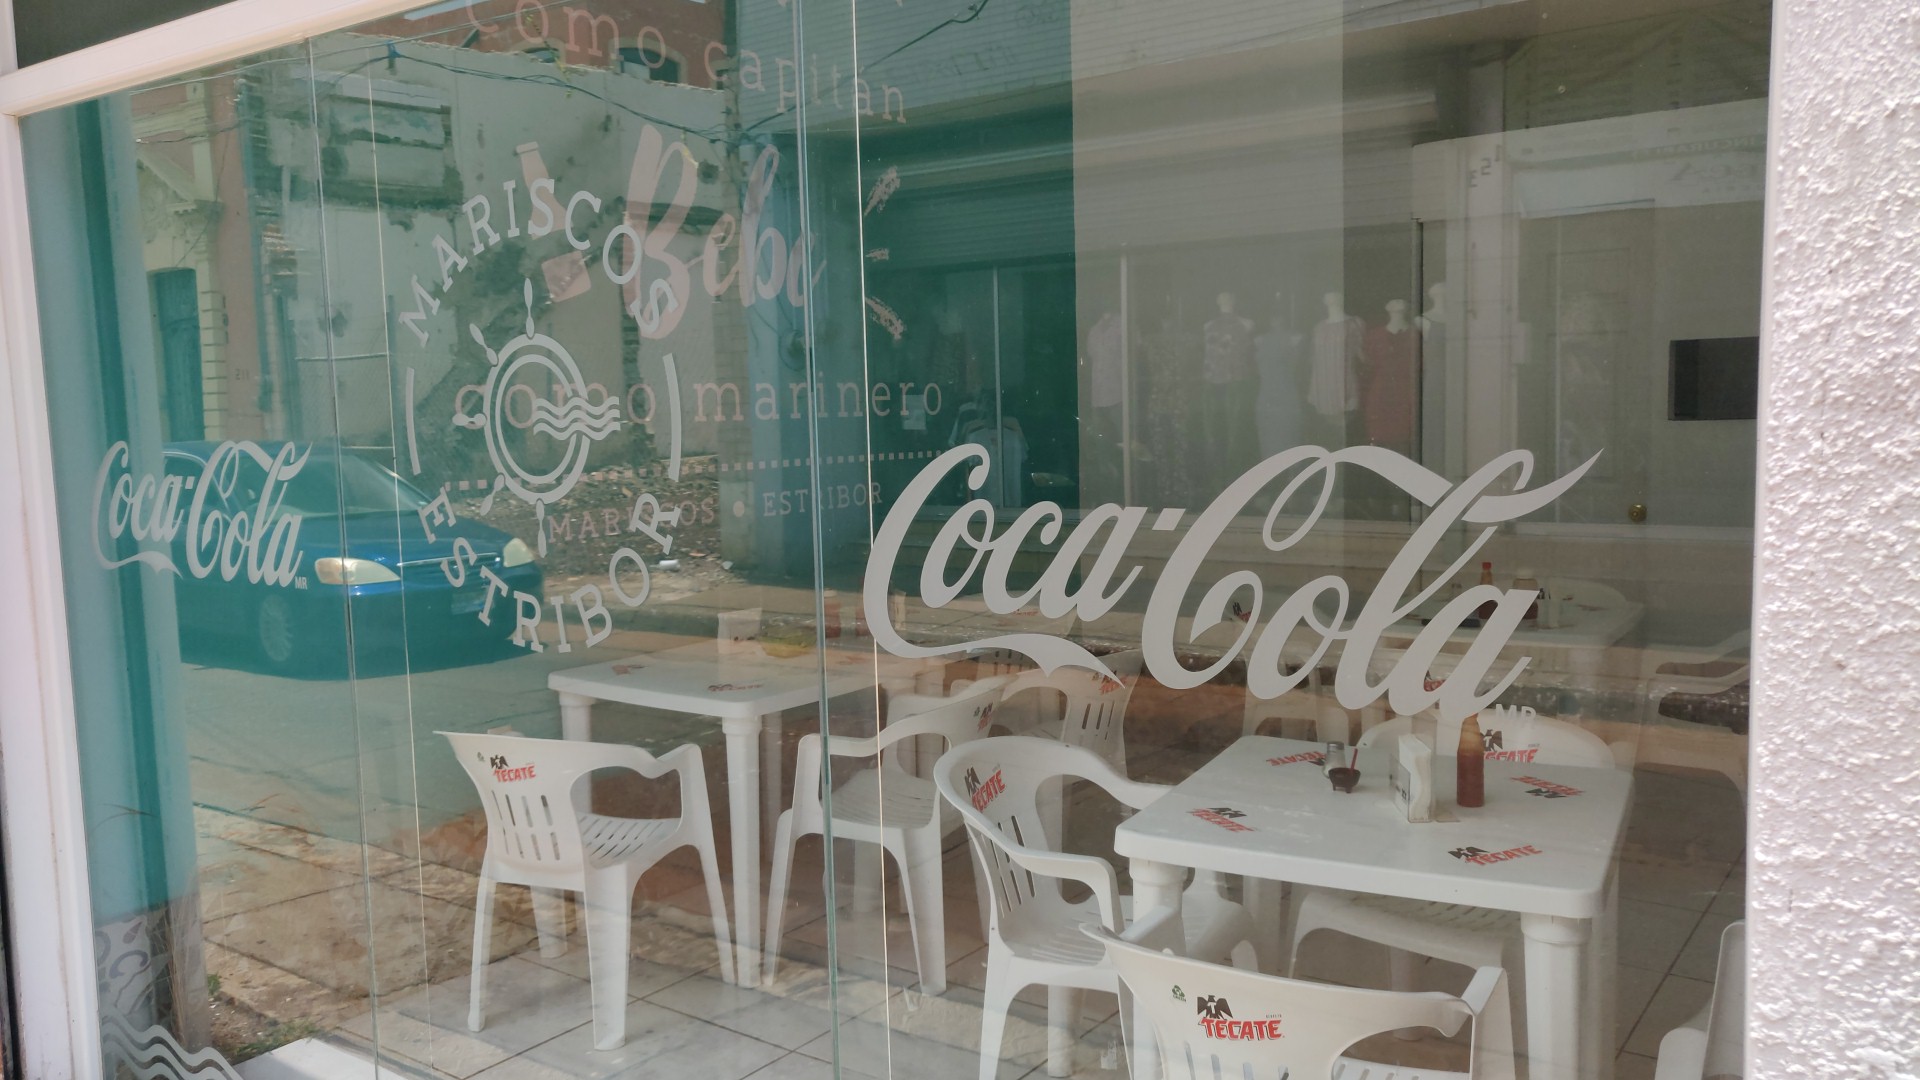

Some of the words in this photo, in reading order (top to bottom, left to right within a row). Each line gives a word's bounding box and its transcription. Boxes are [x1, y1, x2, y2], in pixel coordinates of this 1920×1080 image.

[465, 0, 667, 69] como
[400, 178, 678, 347] MARISCOS
[692, 371, 942, 422] marinero
[92, 440, 312, 587] Coca-Cola
[417, 487, 681, 654] ESTRIBOR
[864, 443, 1604, 717] Coca-Cola
[1495, 703, 1537, 729] MR
[493, 765, 536, 783] TECATE
[971, 769, 1006, 813] TECATE
[1464, 844, 1543, 867] TECATE
[1199, 1017, 1284, 1041] TECATE
